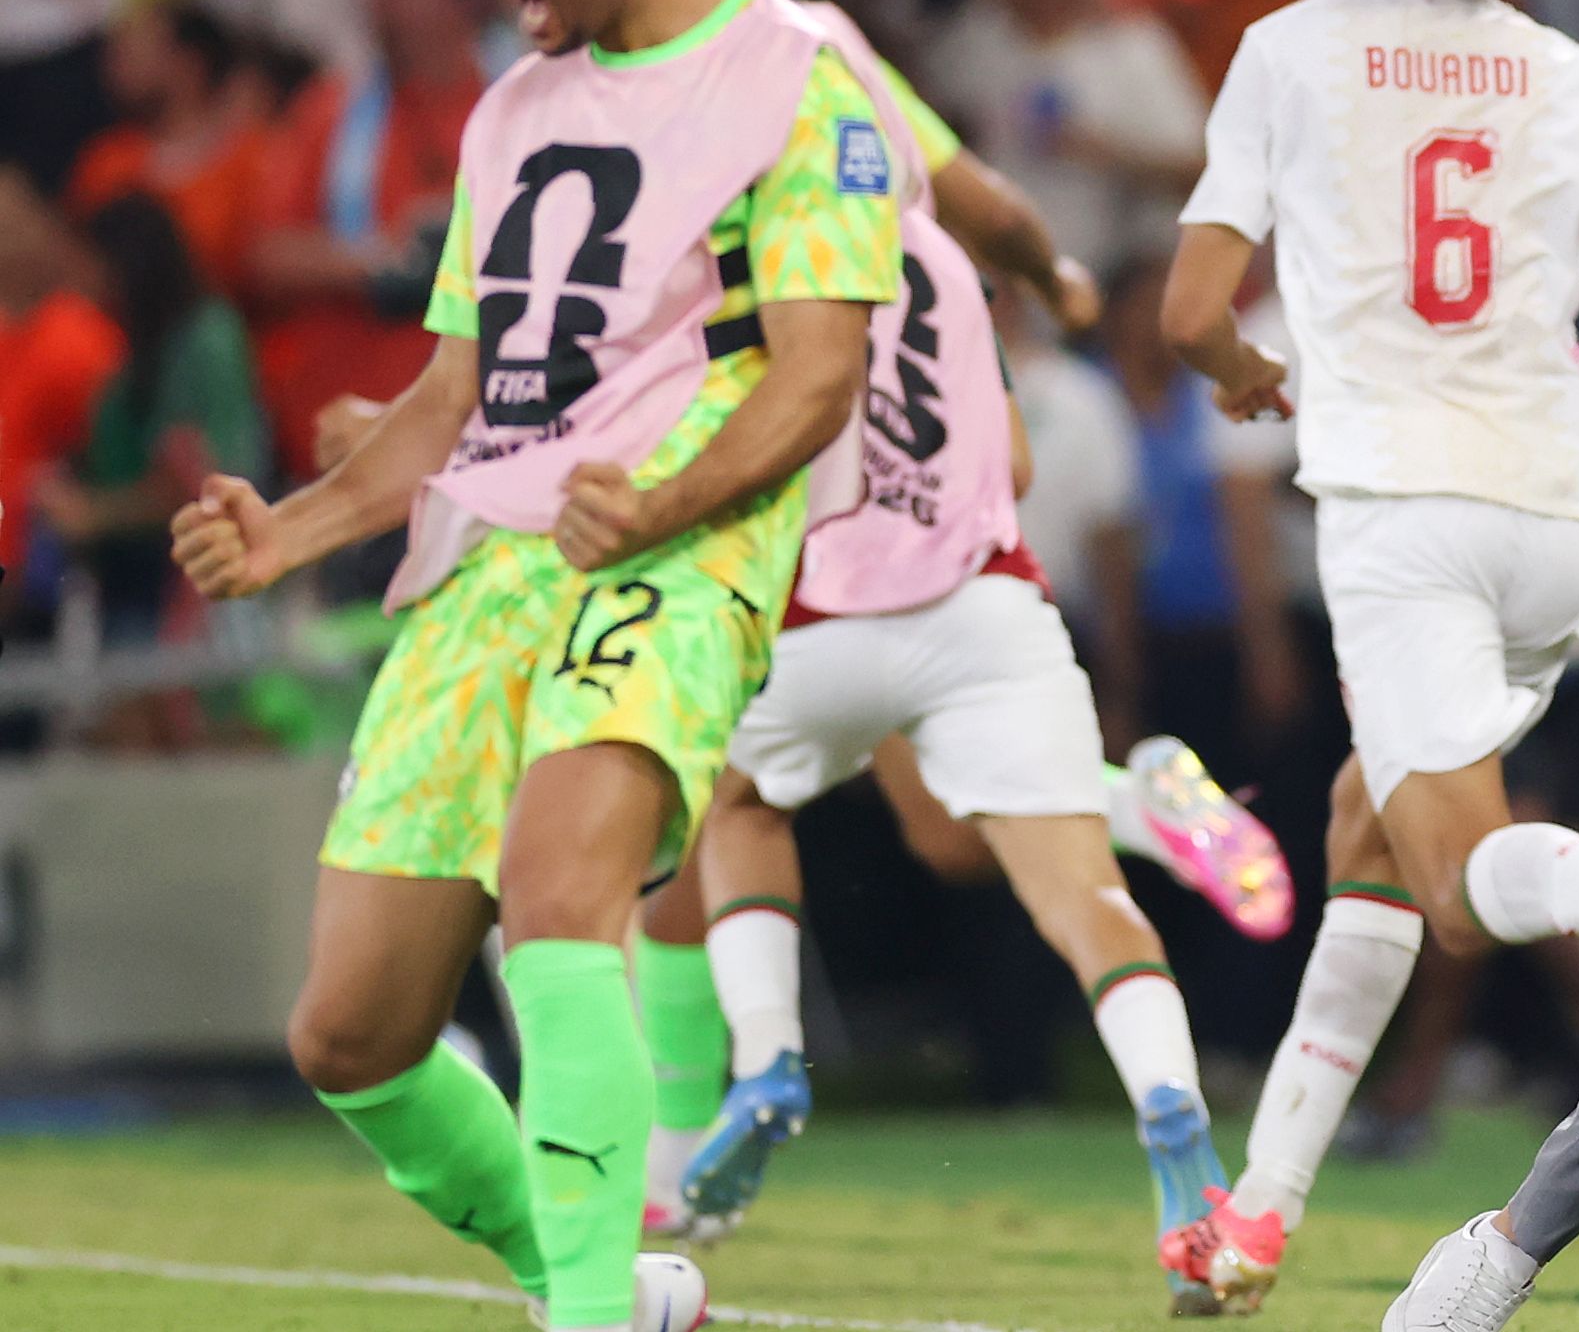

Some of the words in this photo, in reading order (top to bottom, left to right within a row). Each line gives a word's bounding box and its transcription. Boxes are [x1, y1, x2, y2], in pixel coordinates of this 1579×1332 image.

[1366, 46, 1528, 97] BOUADDI
[1404, 127, 1502, 335] 6
[485, 369, 547, 405] FIFA
[553, 581, 662, 676] 12
